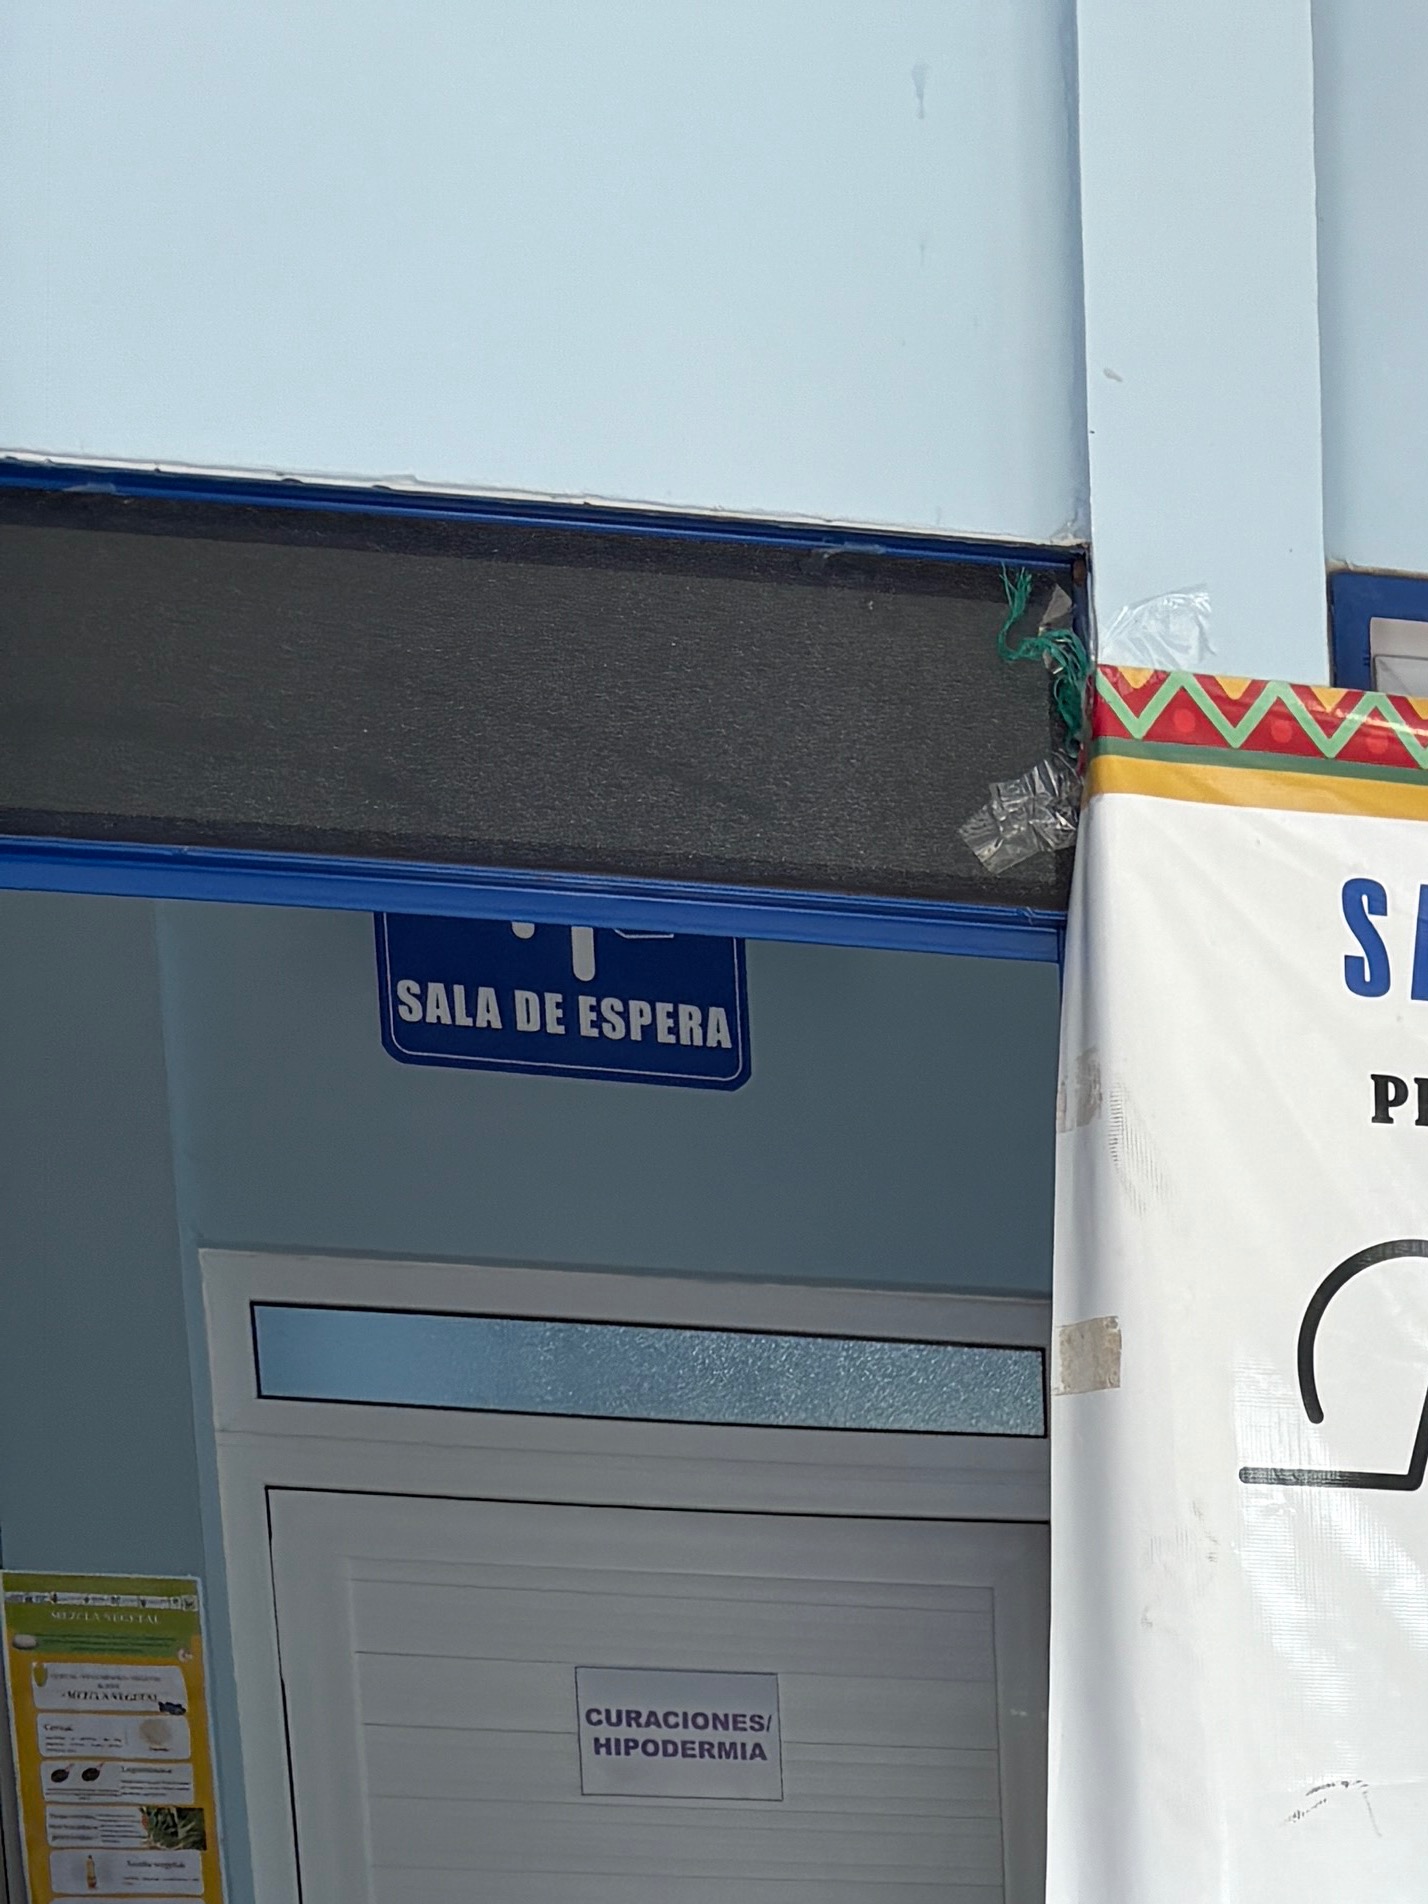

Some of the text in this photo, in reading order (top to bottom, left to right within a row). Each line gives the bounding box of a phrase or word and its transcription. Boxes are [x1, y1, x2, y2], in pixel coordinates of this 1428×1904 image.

[397, 979, 732, 1049] SALA DE ESPERA
[585, 1707, 772, 1733] CURACIONES/
[593, 1736, 768, 1762] HIPODERMIA
